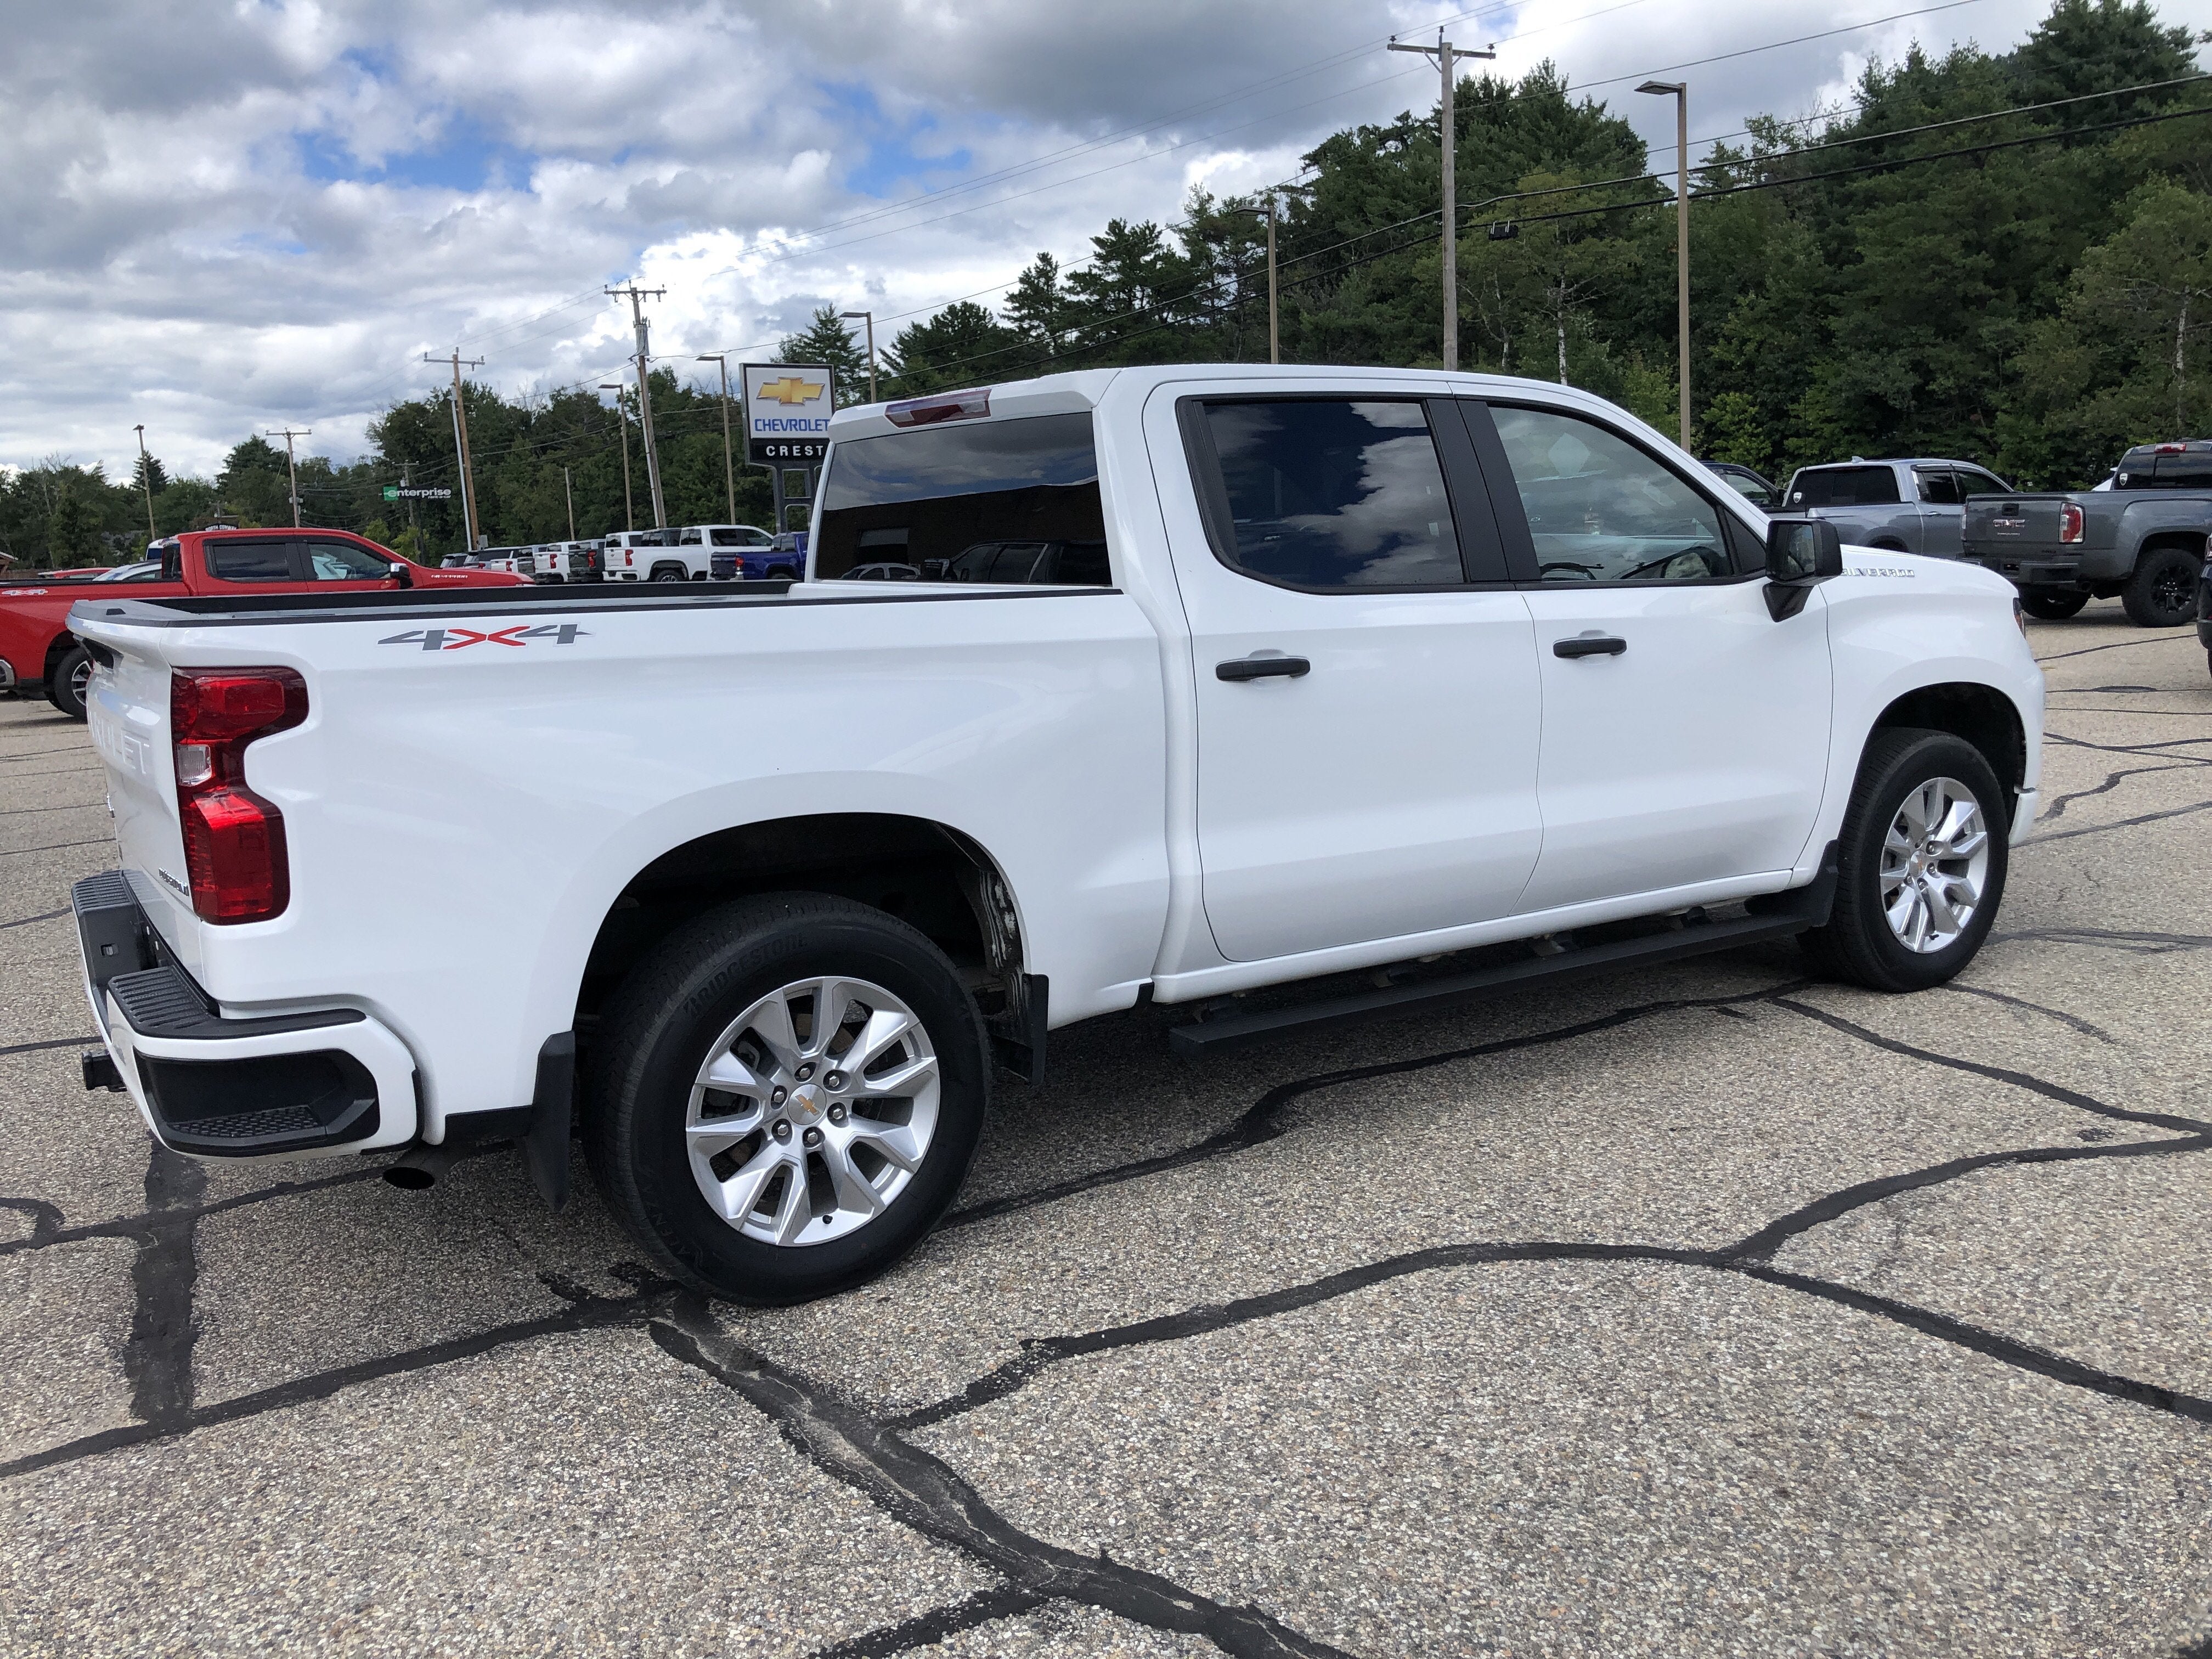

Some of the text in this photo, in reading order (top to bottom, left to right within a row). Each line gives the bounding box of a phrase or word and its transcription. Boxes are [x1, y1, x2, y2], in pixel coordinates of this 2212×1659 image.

[755, 419, 830, 432] CHEVROLET
[766, 445, 823, 456] CREST
[384, 487, 452, 498] enterprise
[1993, 519, 2025, 528] GMC
